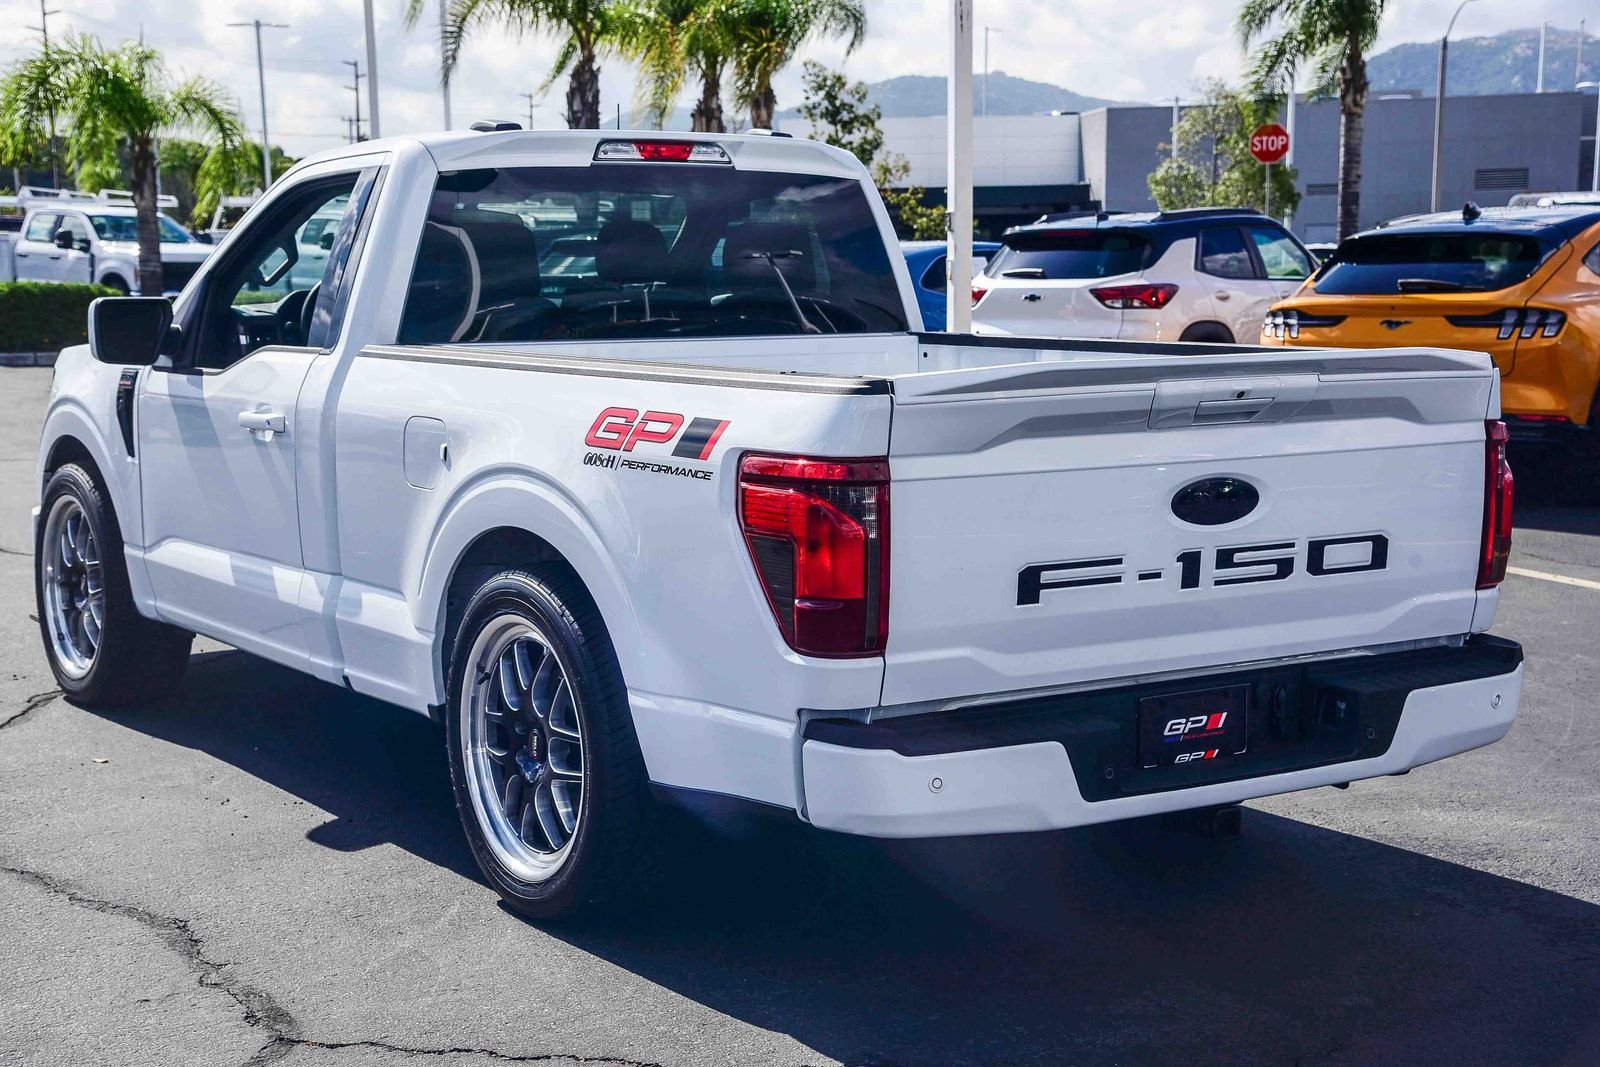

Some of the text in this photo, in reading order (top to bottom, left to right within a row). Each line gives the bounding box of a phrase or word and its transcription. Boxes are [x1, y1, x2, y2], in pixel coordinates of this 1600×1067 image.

[1252, 135, 1288, 152] STOP
[621, 459, 713, 480] PERFORMANCE
[1016, 533, 1389, 606] F-150
